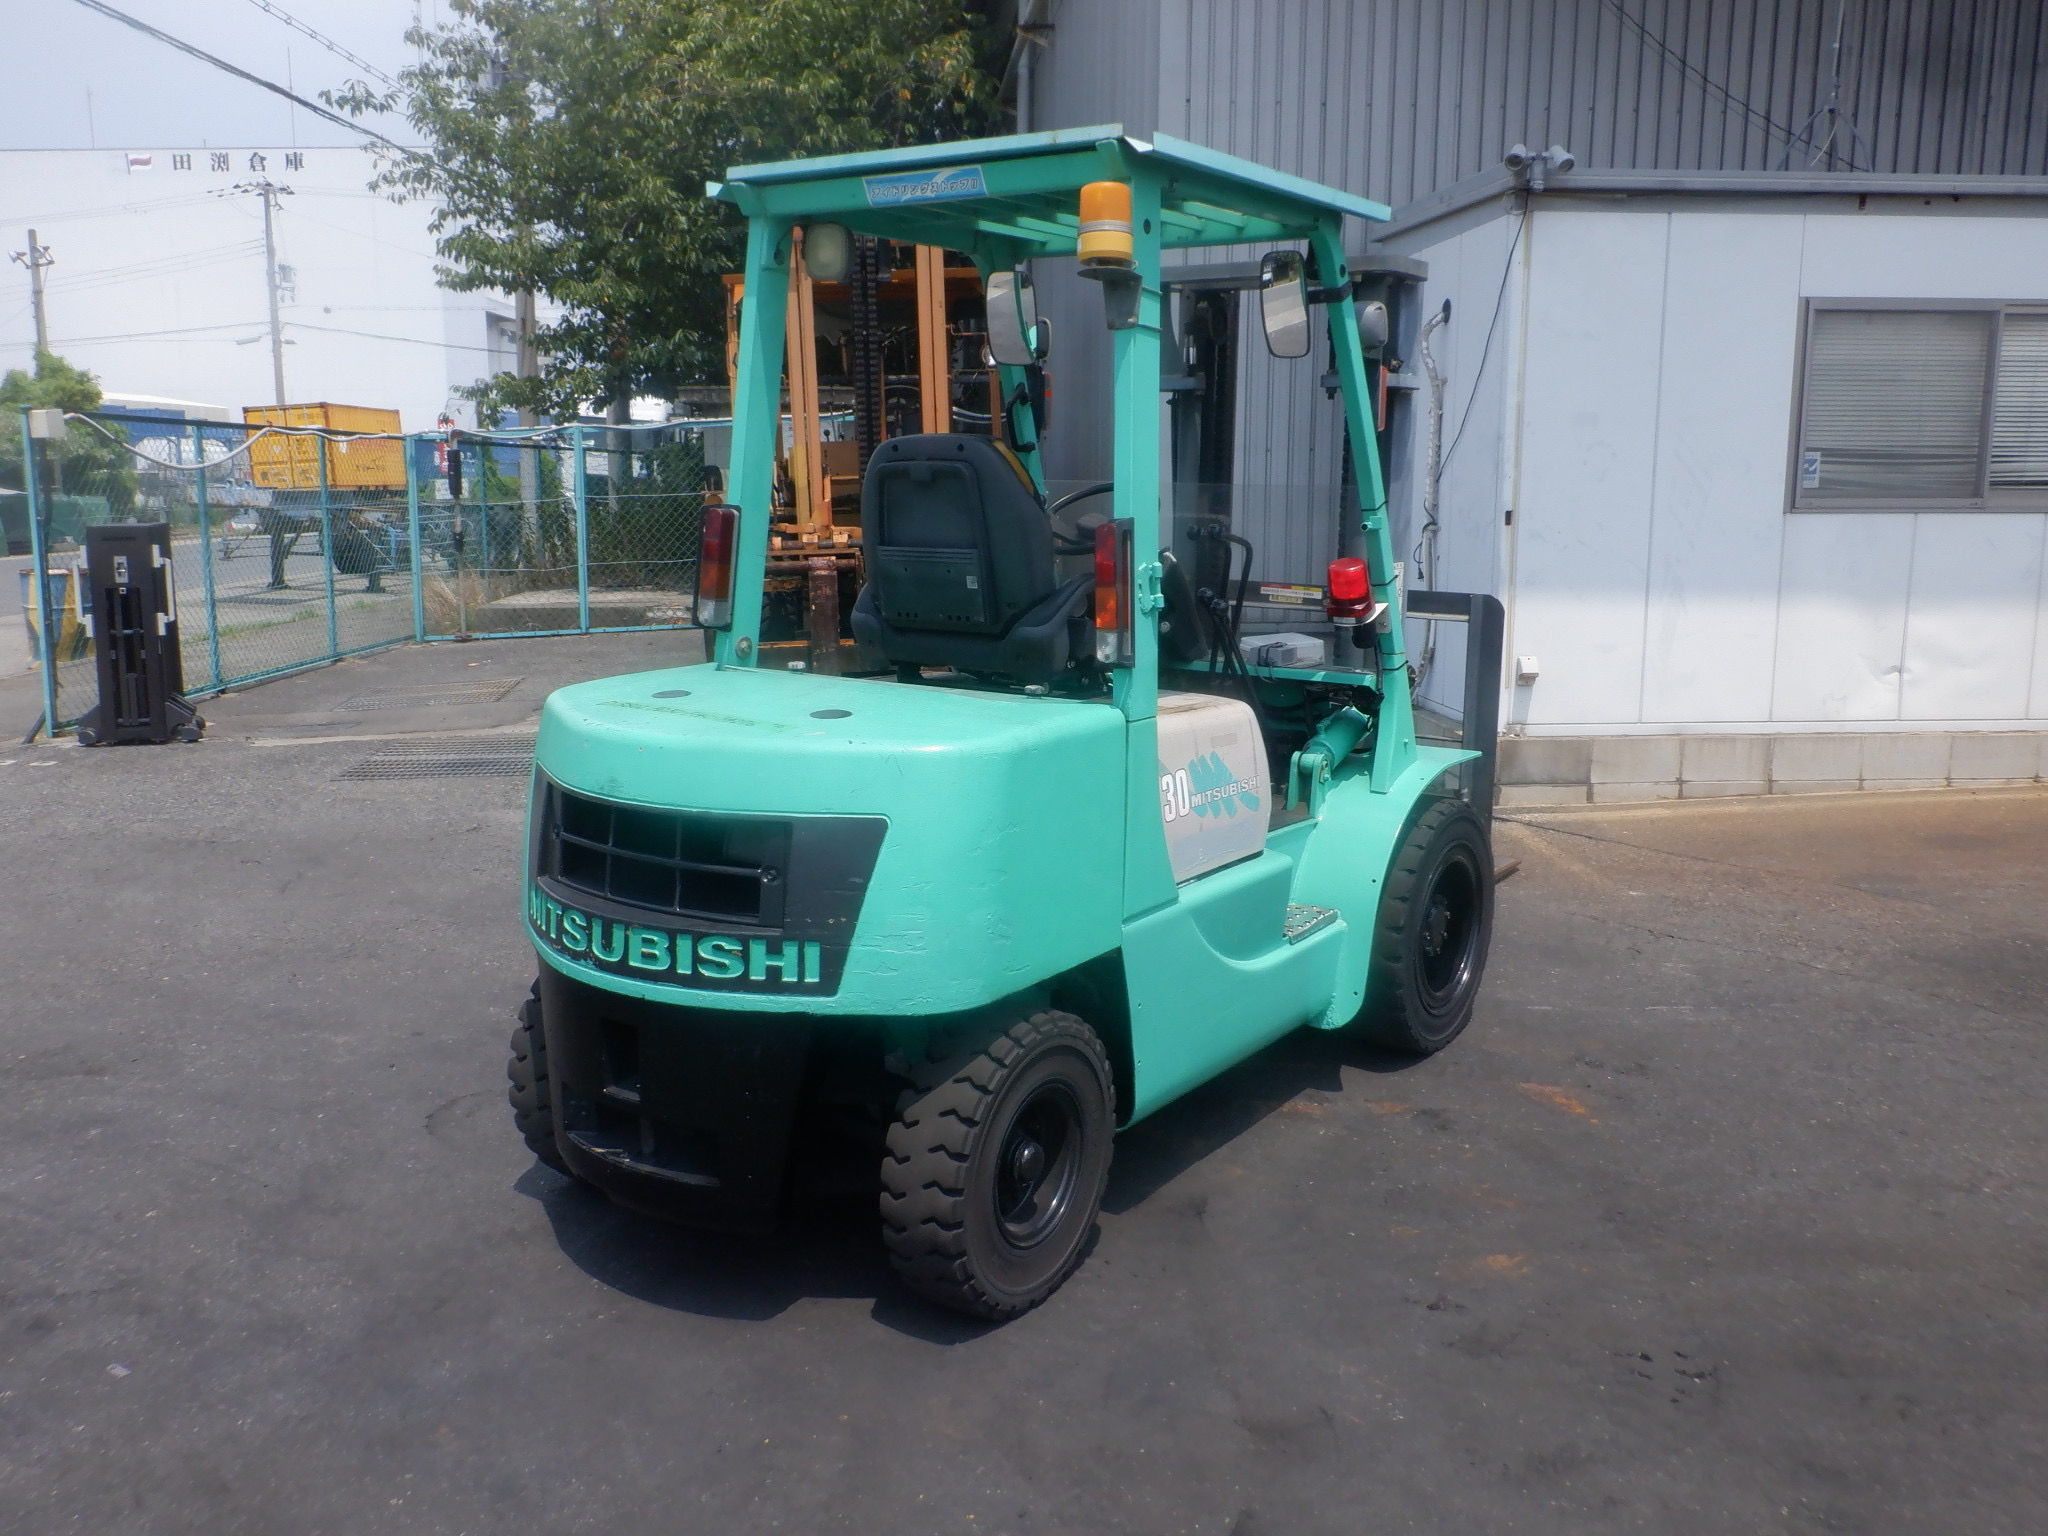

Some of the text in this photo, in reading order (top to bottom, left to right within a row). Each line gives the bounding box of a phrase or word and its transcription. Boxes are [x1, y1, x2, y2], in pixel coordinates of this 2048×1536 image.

[1161, 769, 1260, 823] 30 MITSUBISHI
[528, 879, 821, 983] MITSUBISHI
